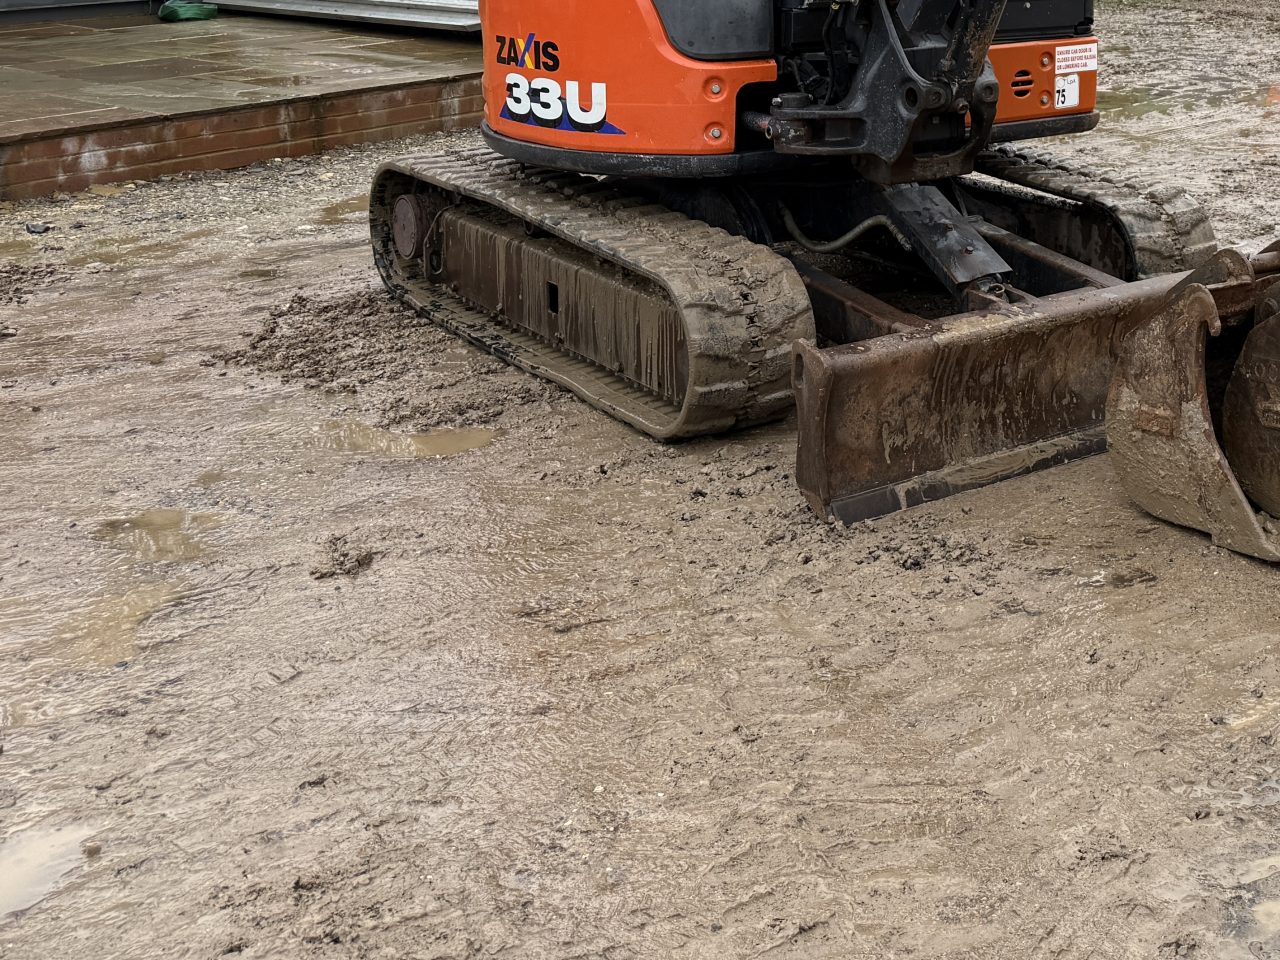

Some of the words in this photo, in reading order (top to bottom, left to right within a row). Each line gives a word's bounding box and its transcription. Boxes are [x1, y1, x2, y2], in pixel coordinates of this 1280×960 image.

[496, 32, 560, 72] ZAXIS
[505, 73, 607, 128] 33U
[1056, 89, 1066, 106] 75
